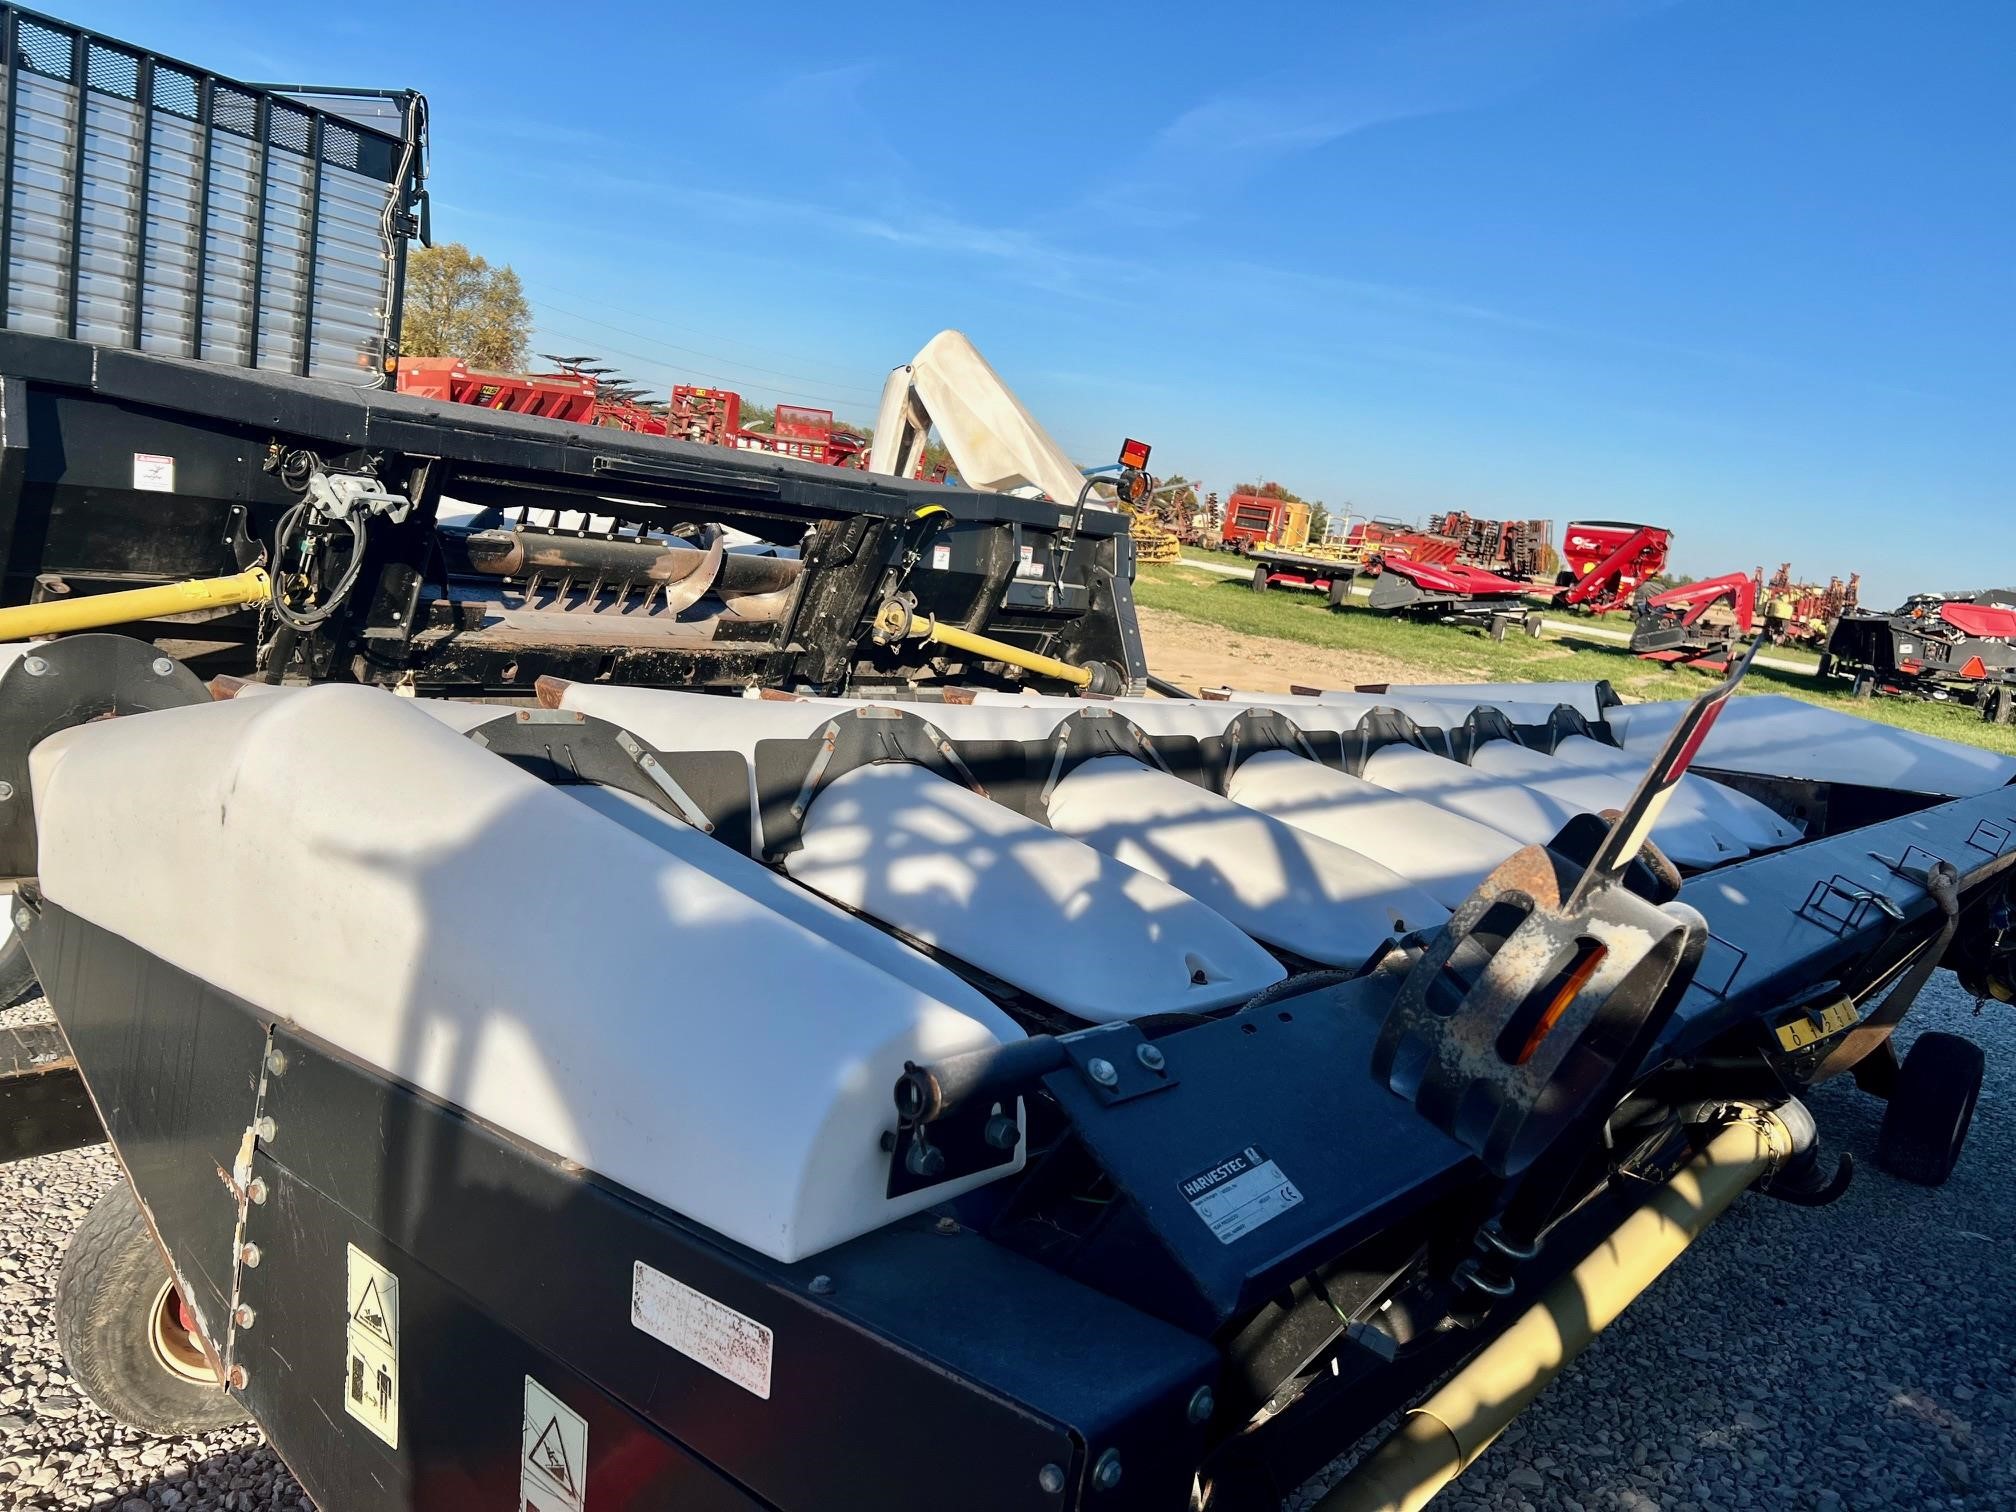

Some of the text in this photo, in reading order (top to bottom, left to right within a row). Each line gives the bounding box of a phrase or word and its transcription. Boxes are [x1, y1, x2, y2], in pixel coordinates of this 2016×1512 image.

[1793, 1034, 1801, 1046] 0
[1811, 1028, 1818, 1039] 1
[1825, 1021, 1834, 1033] 2
[1183, 1157, 1246, 1195] HARVESTEC
